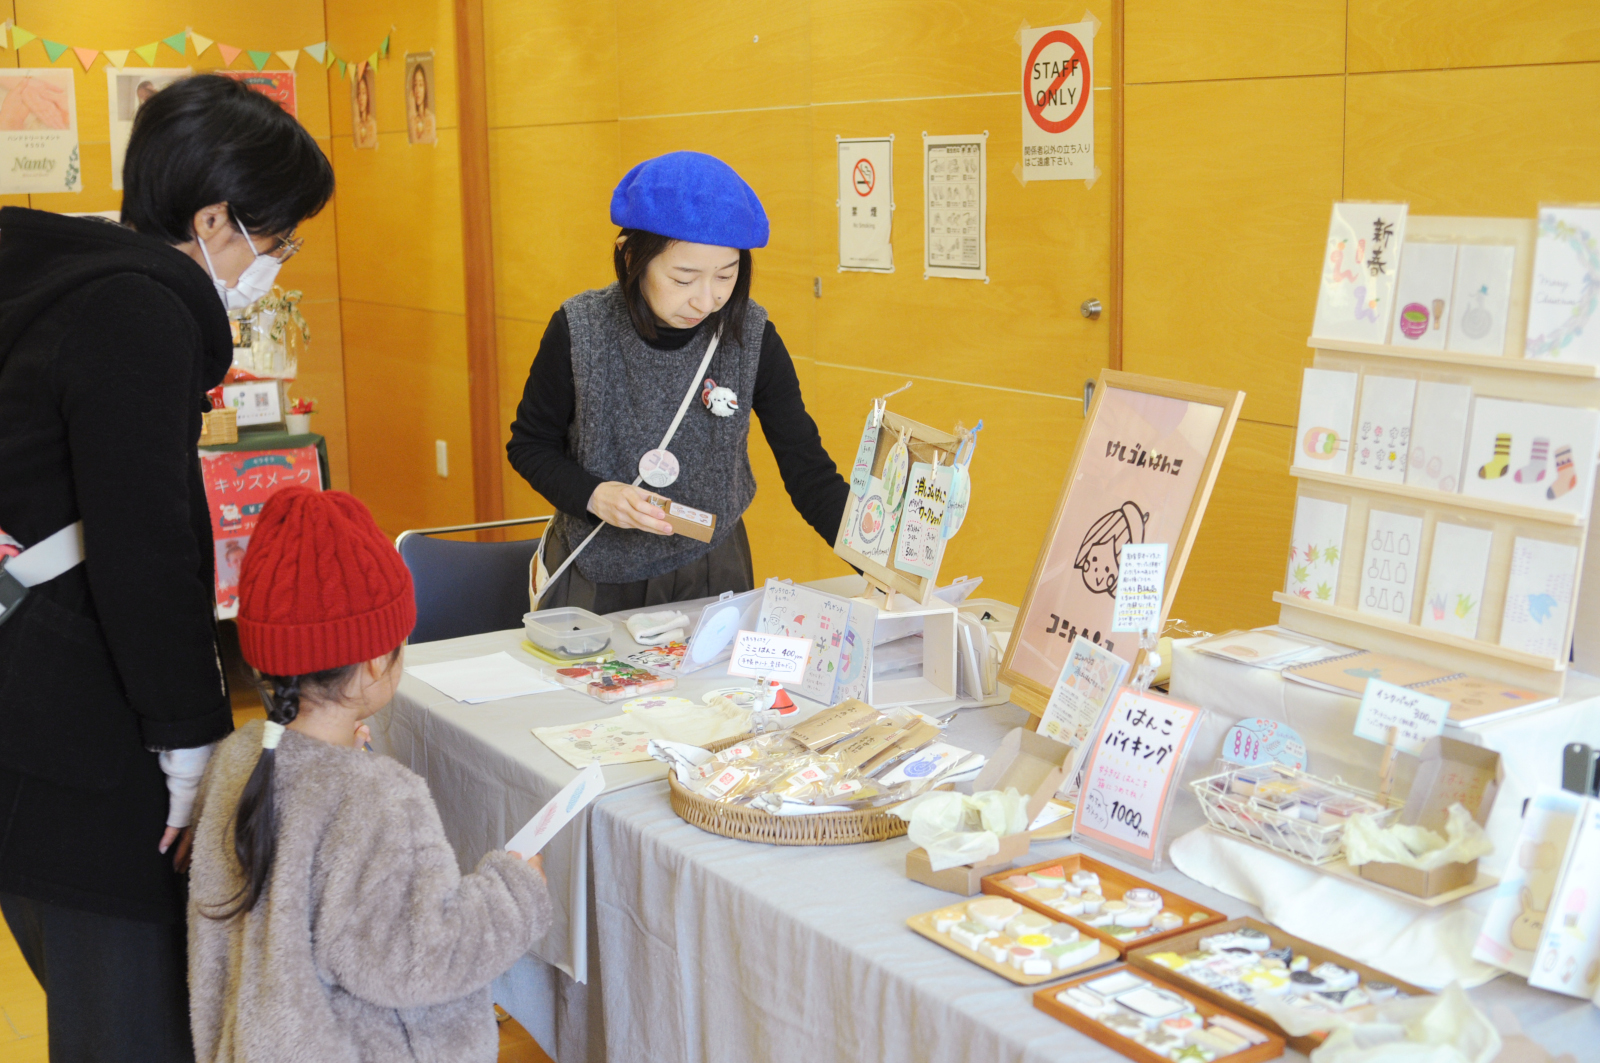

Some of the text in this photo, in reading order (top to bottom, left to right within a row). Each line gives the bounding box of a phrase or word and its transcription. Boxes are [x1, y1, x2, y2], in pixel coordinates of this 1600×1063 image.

[1033, 59, 1079, 80] STAFF
[1036, 87, 1077, 107] ONLY
[1024, 144, 1091, 156] 関係者以外の立ち入り
[11, 156, 56, 173] Nanty
[1024, 156, 1074, 168] はご遠慮下さい。
[1366, 217, 1395, 277] 新春
[215, 468, 311, 494] キッズメーク
[745, 644, 776, 655] ミニはんこ
[1377, 689, 1419, 708] インクパッド
[1126, 709, 1173, 735] はんこ
[1105, 730, 1173, 765] バイキング
